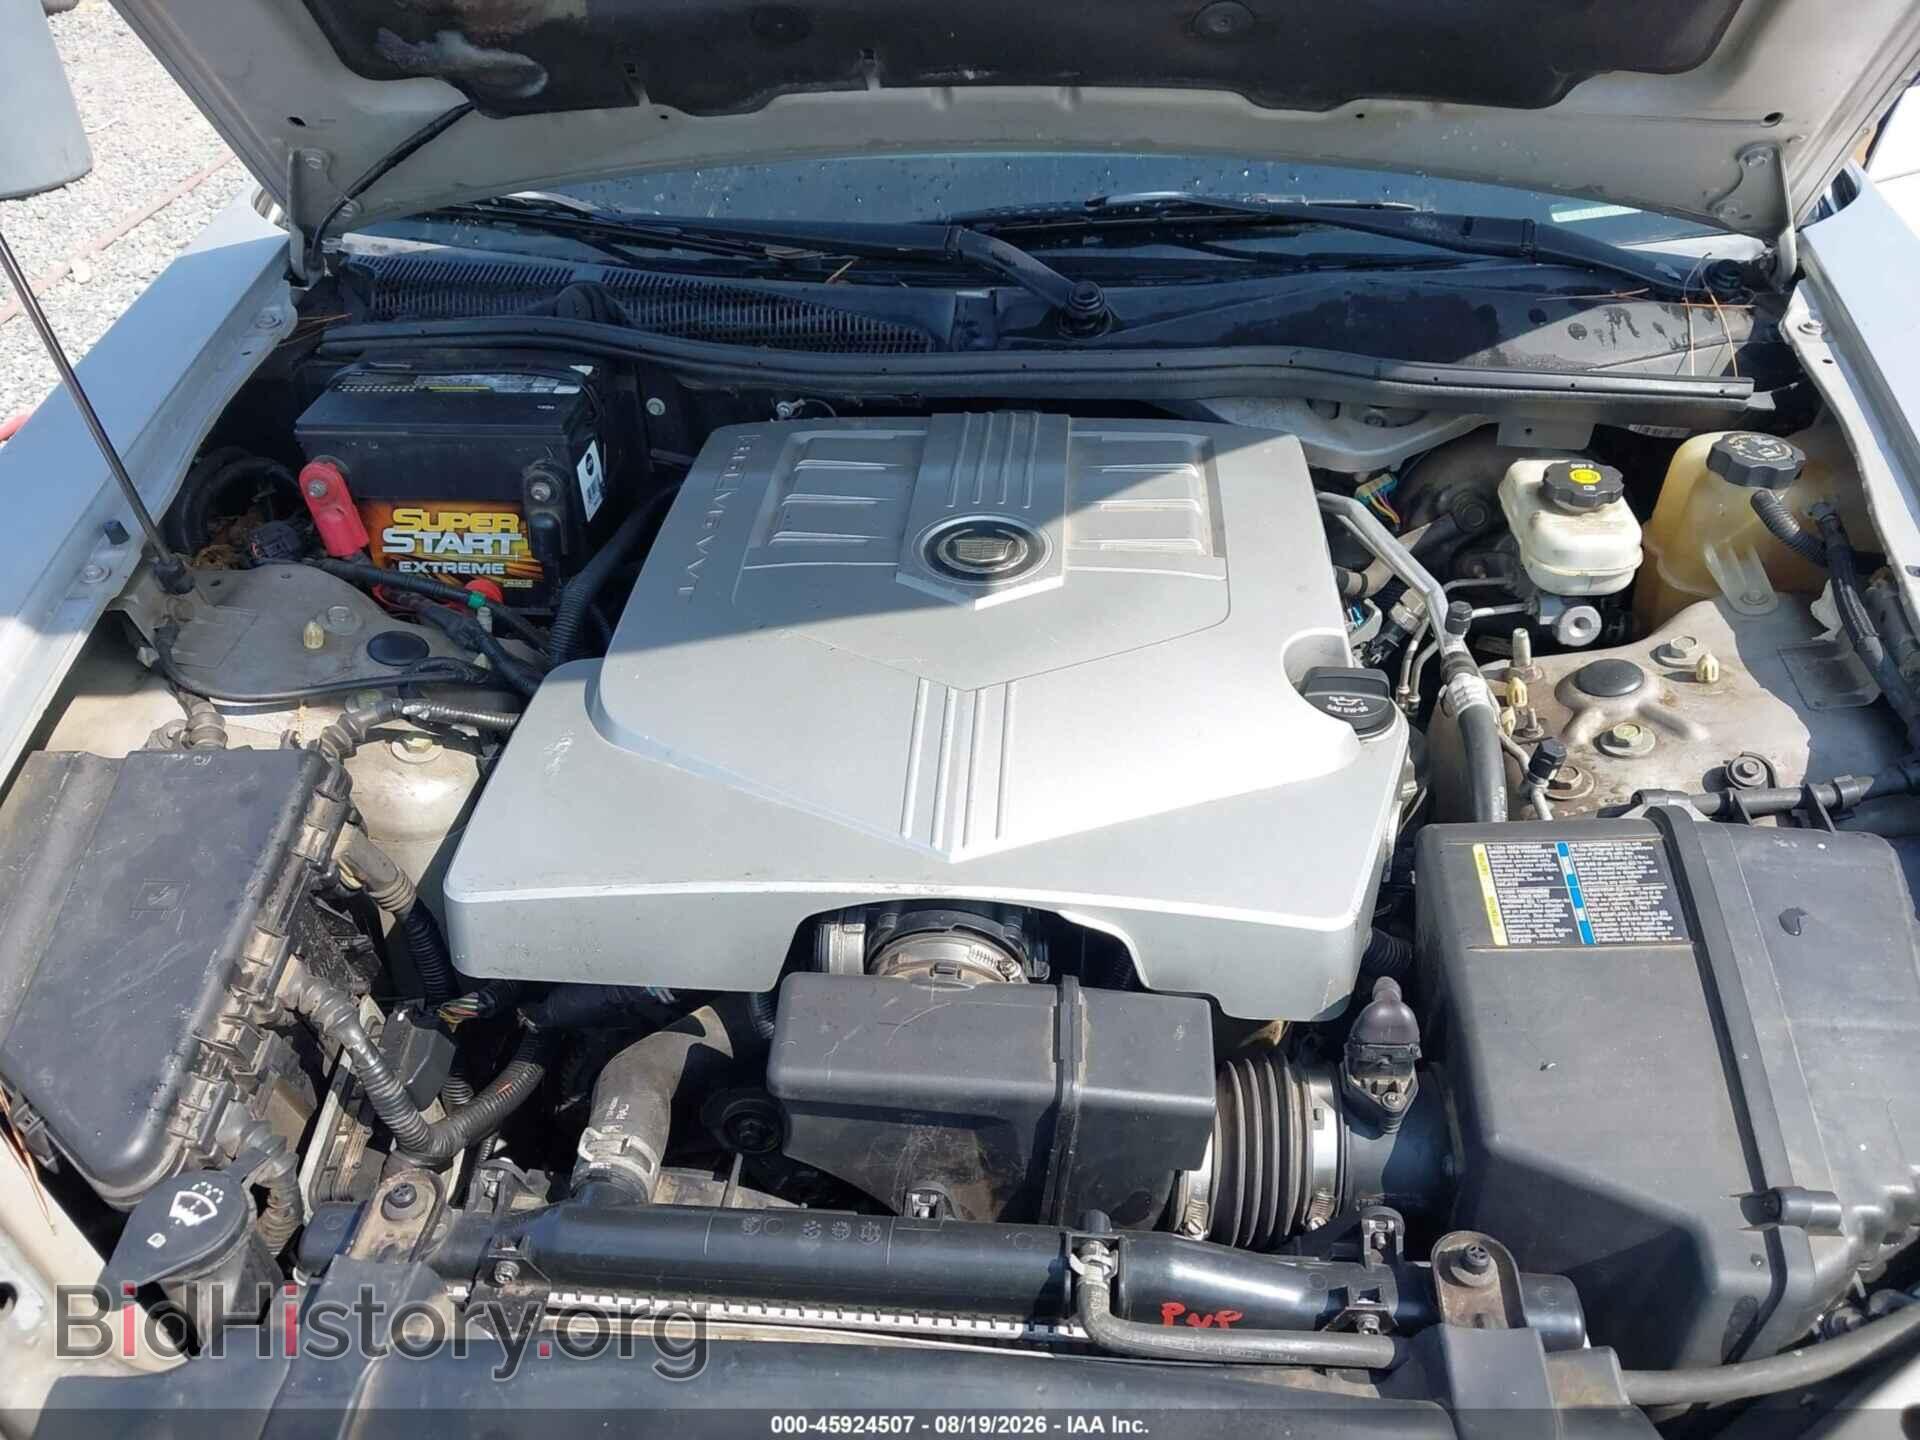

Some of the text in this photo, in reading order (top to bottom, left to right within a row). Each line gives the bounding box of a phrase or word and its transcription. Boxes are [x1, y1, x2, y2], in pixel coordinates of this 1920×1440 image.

[393, 508, 520, 532] SUPER
[382, 527, 523, 554] START
[398, 561, 506, 575] EXTREME
